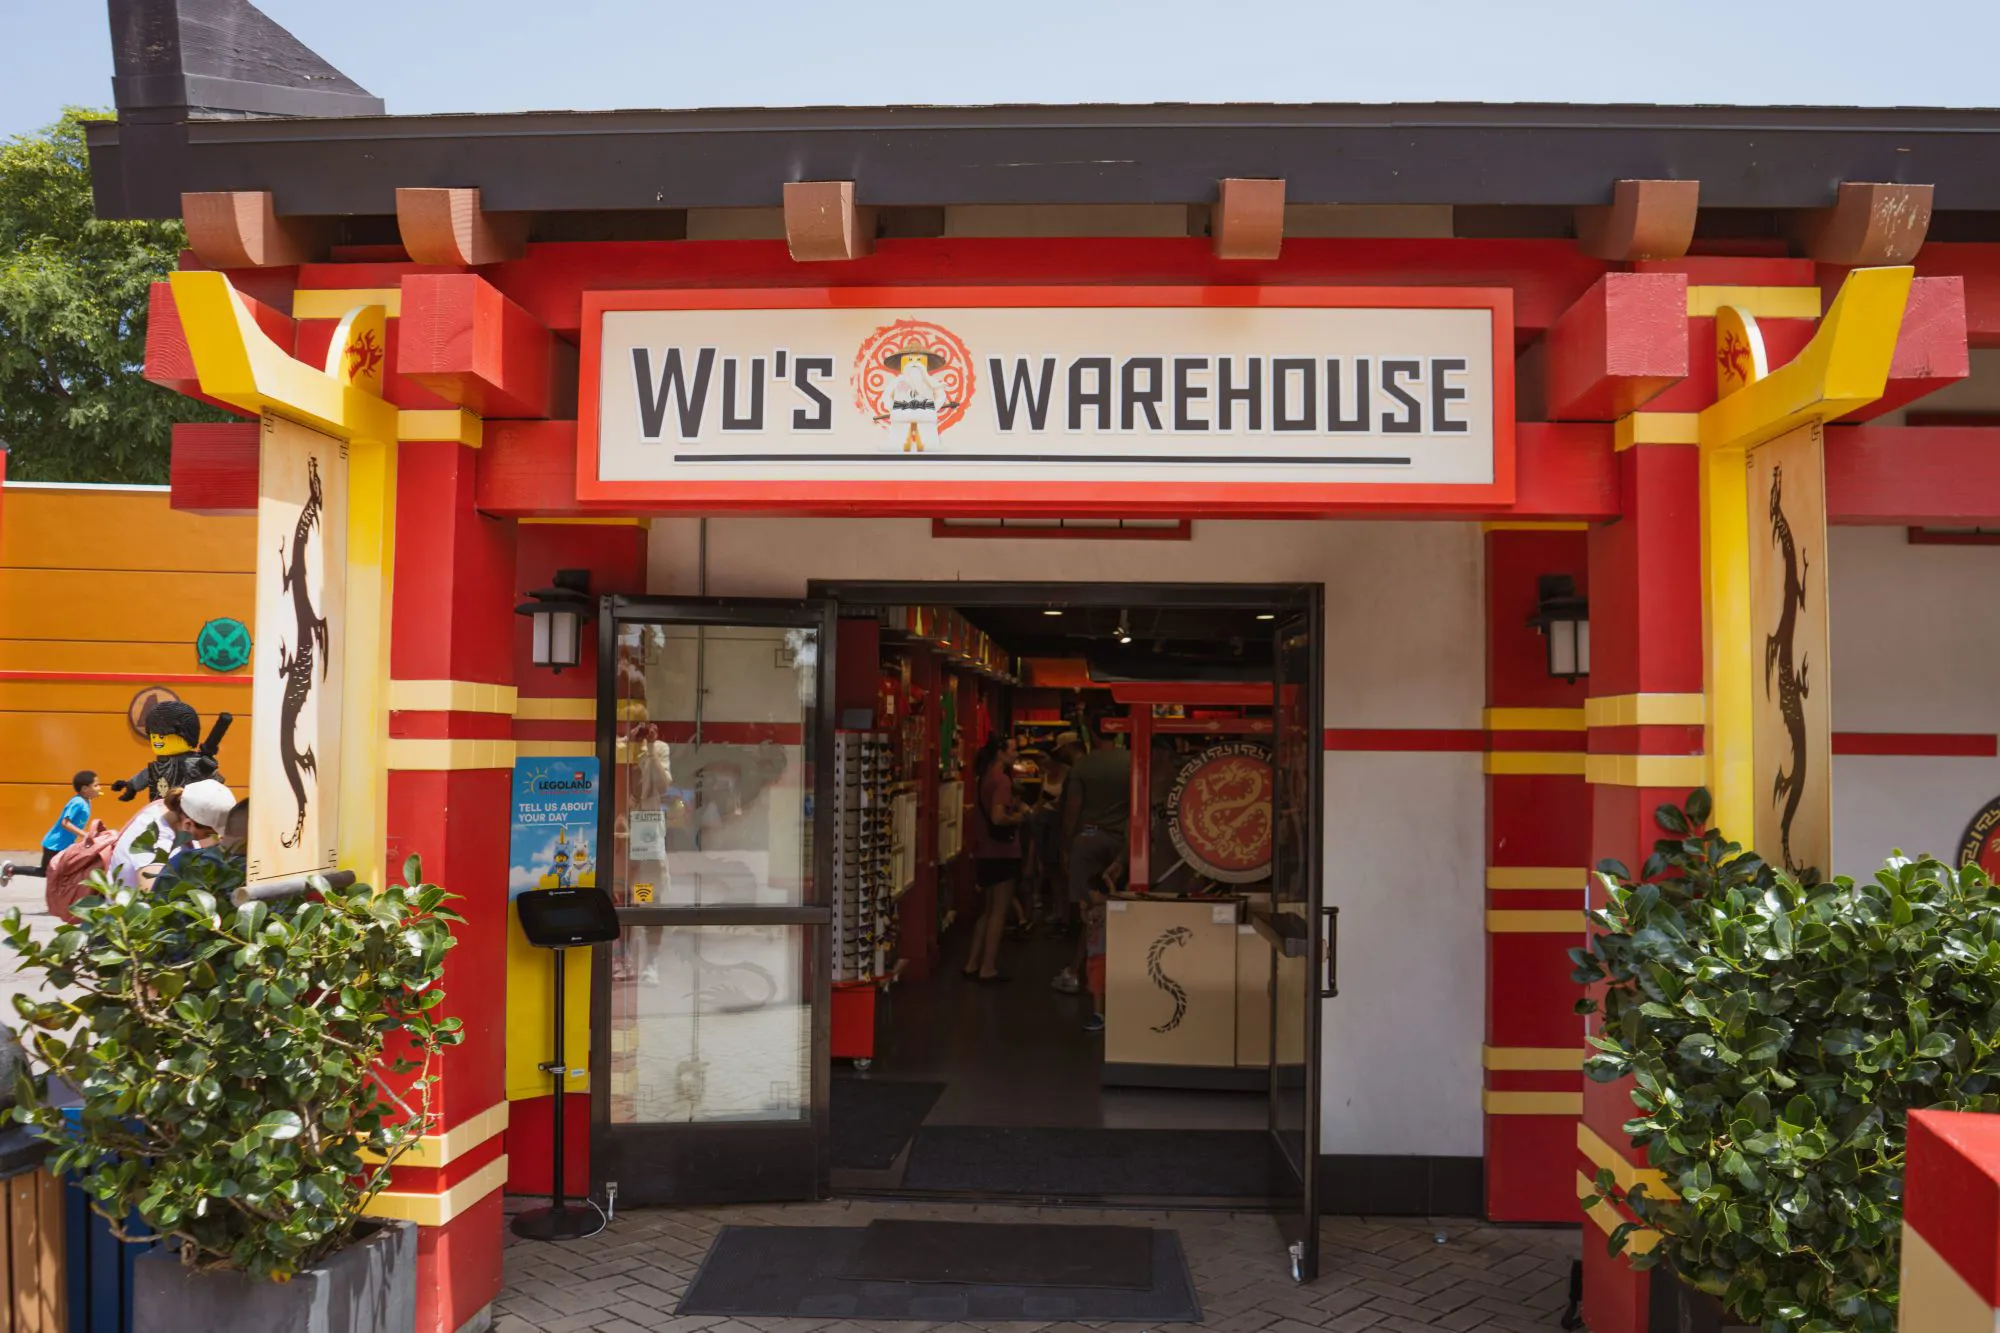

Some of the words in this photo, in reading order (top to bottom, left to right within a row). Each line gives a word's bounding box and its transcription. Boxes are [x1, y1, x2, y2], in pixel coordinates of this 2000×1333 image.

[632, 348, 833, 438] WU'S
[989, 357, 1468, 433] WAREHOUSE
[539, 776, 592, 790] LEGOLAND
[519, 803, 542, 812] TELL
[544, 803, 558, 811] US
[560, 802, 593, 811] ABOUT
[519, 813, 546, 822] YOUR
[548, 813, 568, 822] DAY
